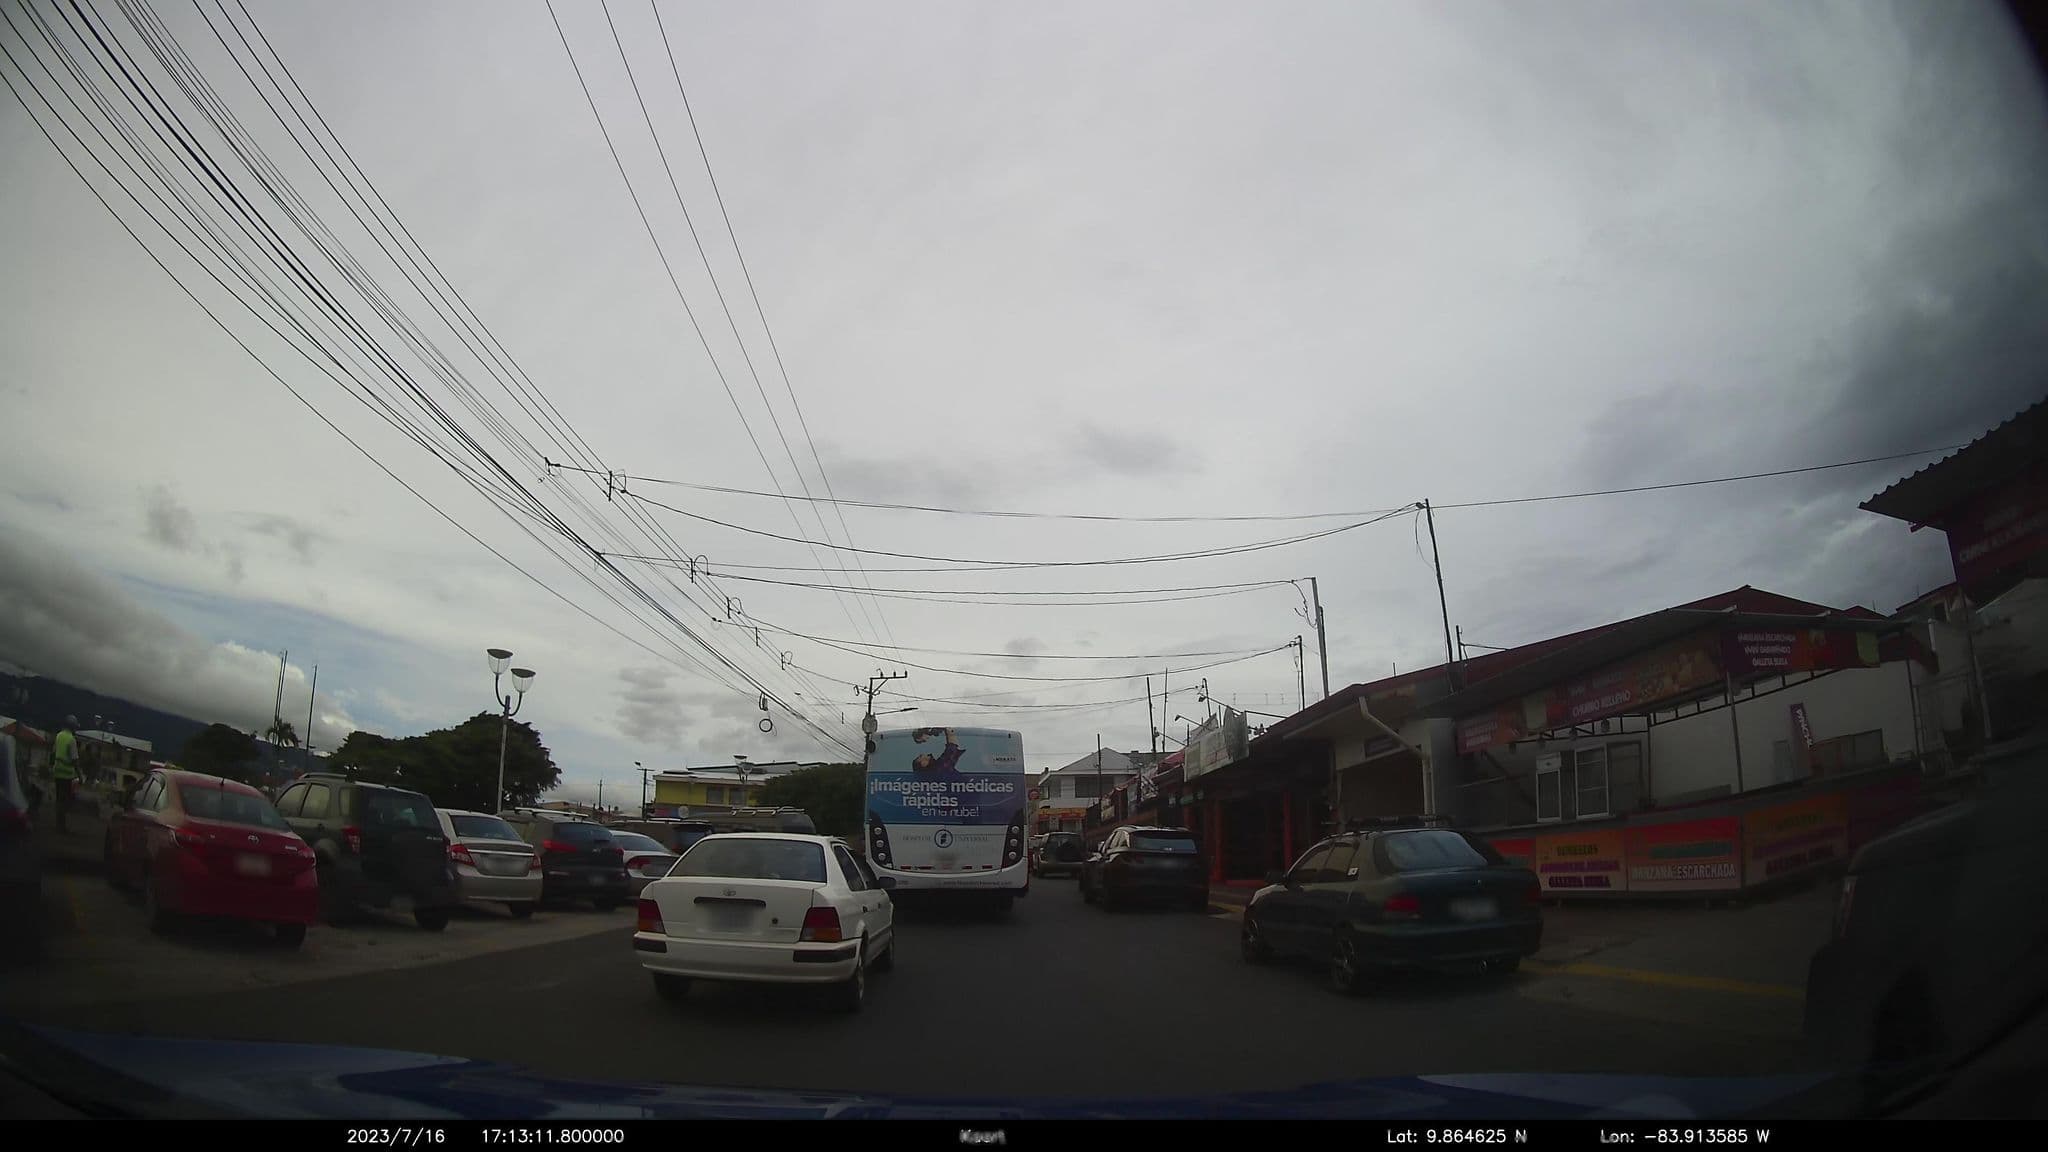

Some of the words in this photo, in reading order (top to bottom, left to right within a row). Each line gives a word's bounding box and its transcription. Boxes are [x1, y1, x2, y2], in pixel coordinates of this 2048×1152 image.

[870, 777, 947, 796] ¡Imágenes
[951, 777, 1014, 793] médicas
[902, 793, 959, 809] rápidas
[921, 807, 936, 817] en
[949, 806, 980, 817] nube!
